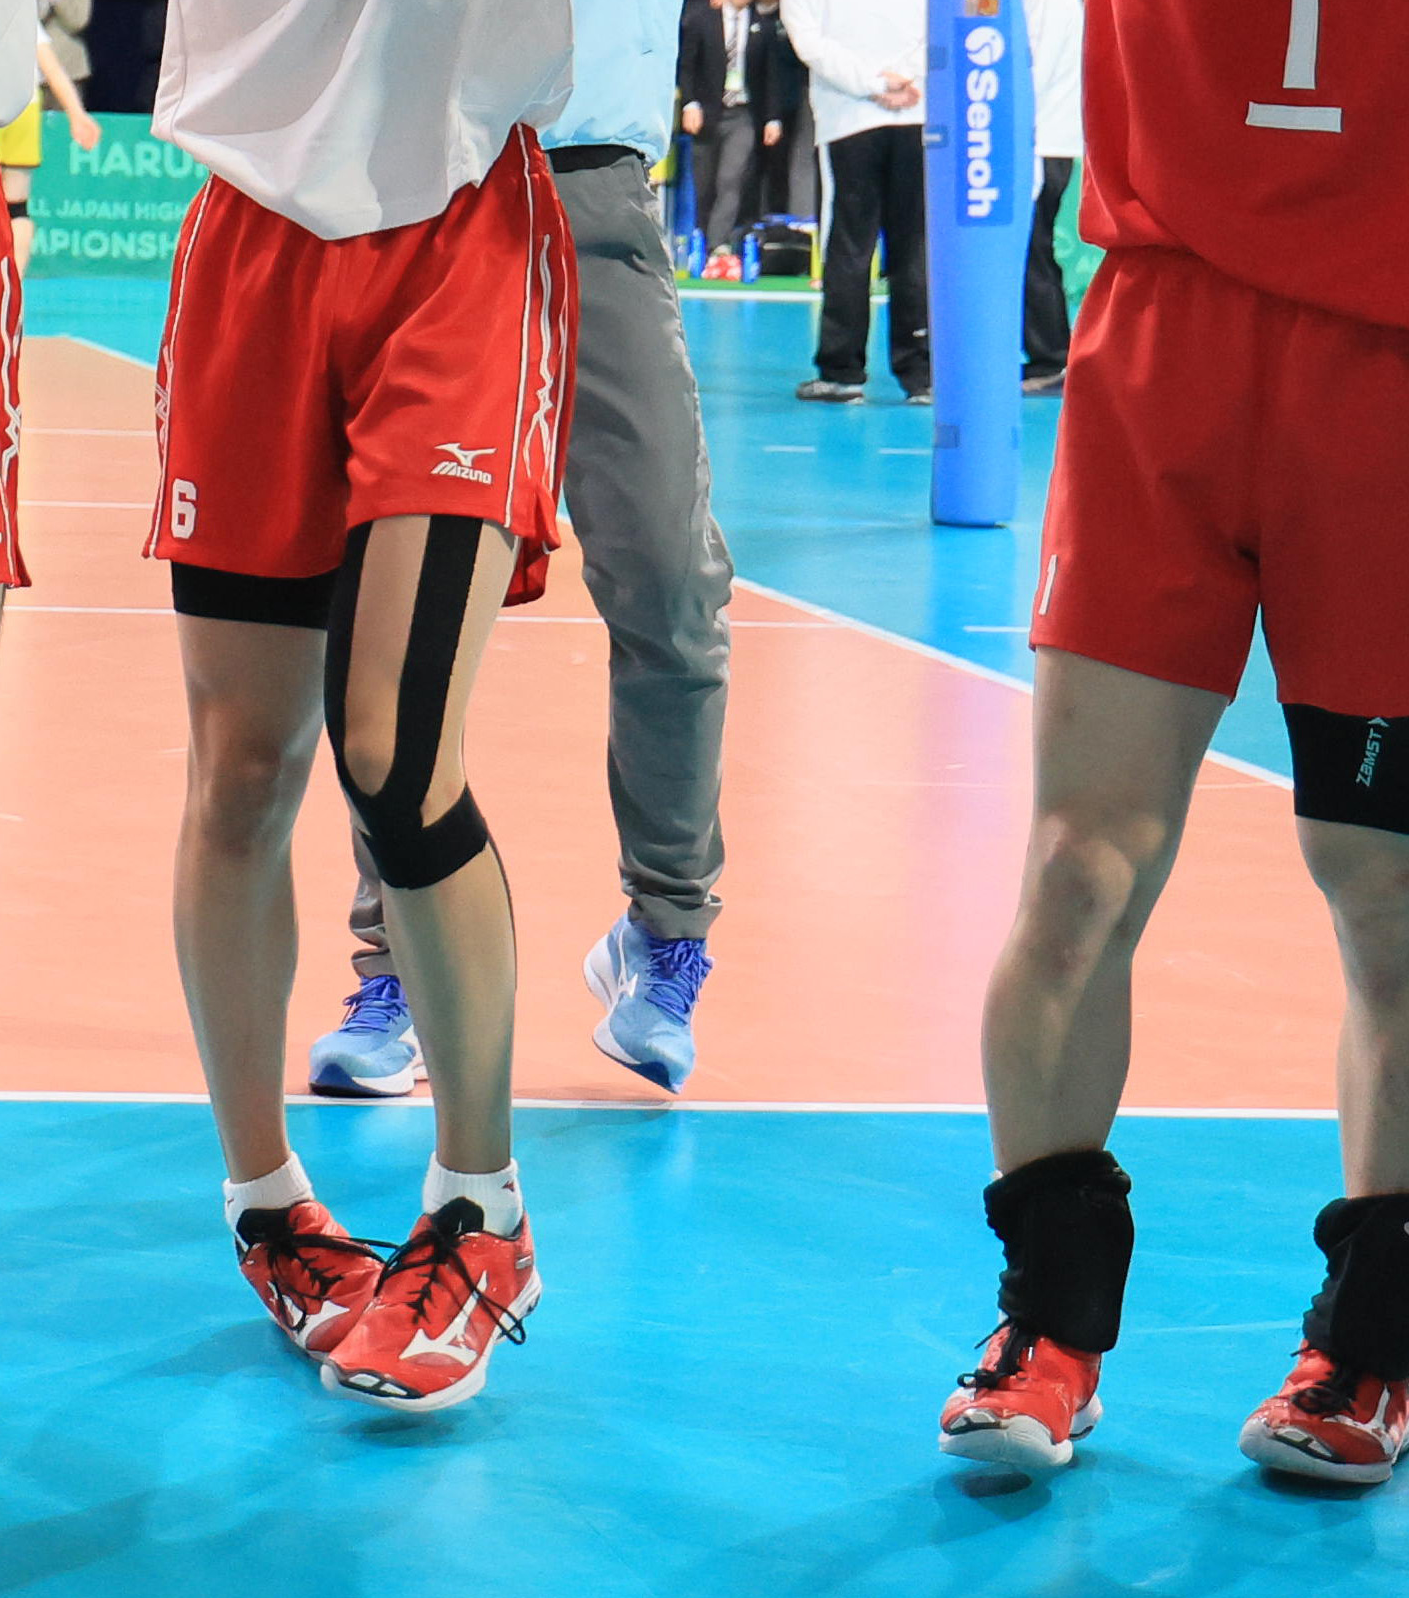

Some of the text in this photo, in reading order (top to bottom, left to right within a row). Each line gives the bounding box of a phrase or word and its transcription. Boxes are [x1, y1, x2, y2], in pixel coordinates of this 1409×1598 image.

[966, 69, 1000, 218] Senoh
[56, 199, 129, 219] JAPAN
[430, 460, 492, 485] MIZUNO
[171, 479, 198, 539] 6
[1038, 553, 1059, 615] 1
[1355, 727, 1383, 787] ZAMST
